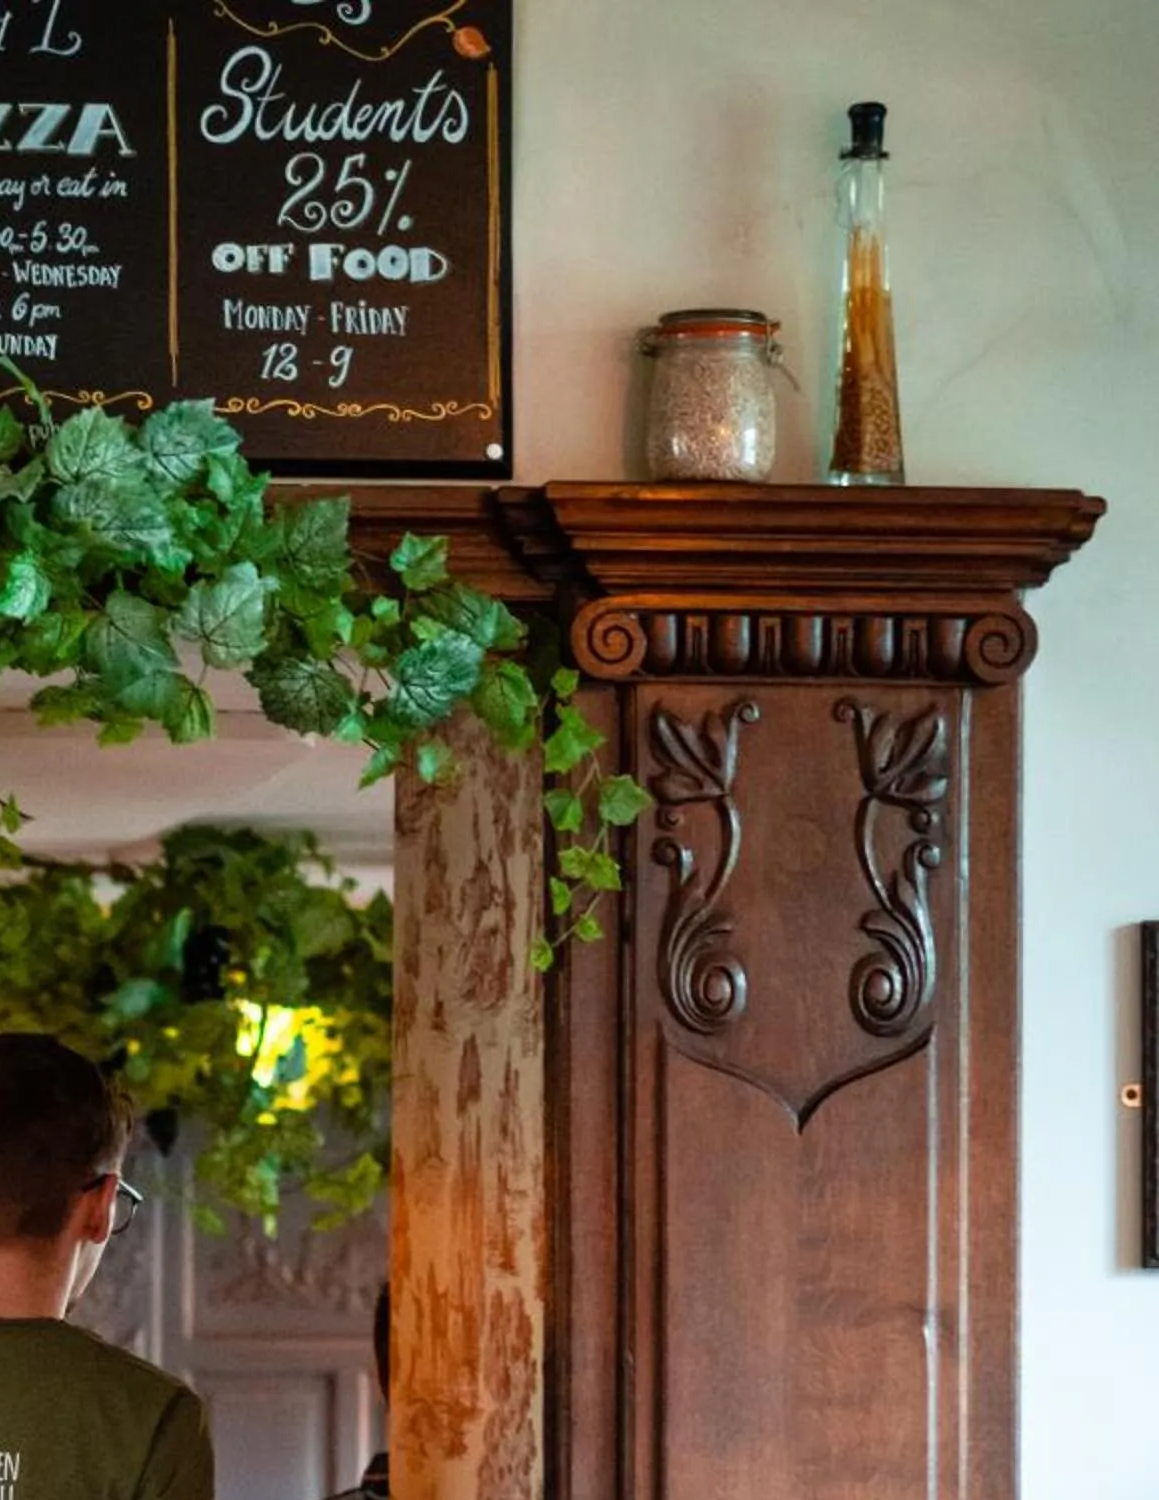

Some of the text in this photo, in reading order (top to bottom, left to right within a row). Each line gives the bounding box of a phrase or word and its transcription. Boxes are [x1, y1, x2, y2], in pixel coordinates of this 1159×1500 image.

[200, 45, 470, 144] Students
[30, 174, 51, 196] or
[56, 167, 98, 198] eat
[98, 171, 129, 198] in
[12, 258, 123, 289] WEDNESDAY
[211, 242, 449, 283] OFF FOOD
[223, 298, 311, 336] MONDAY
[259, 343, 299, 381] 12
[328, 344, 355, 389] 9
